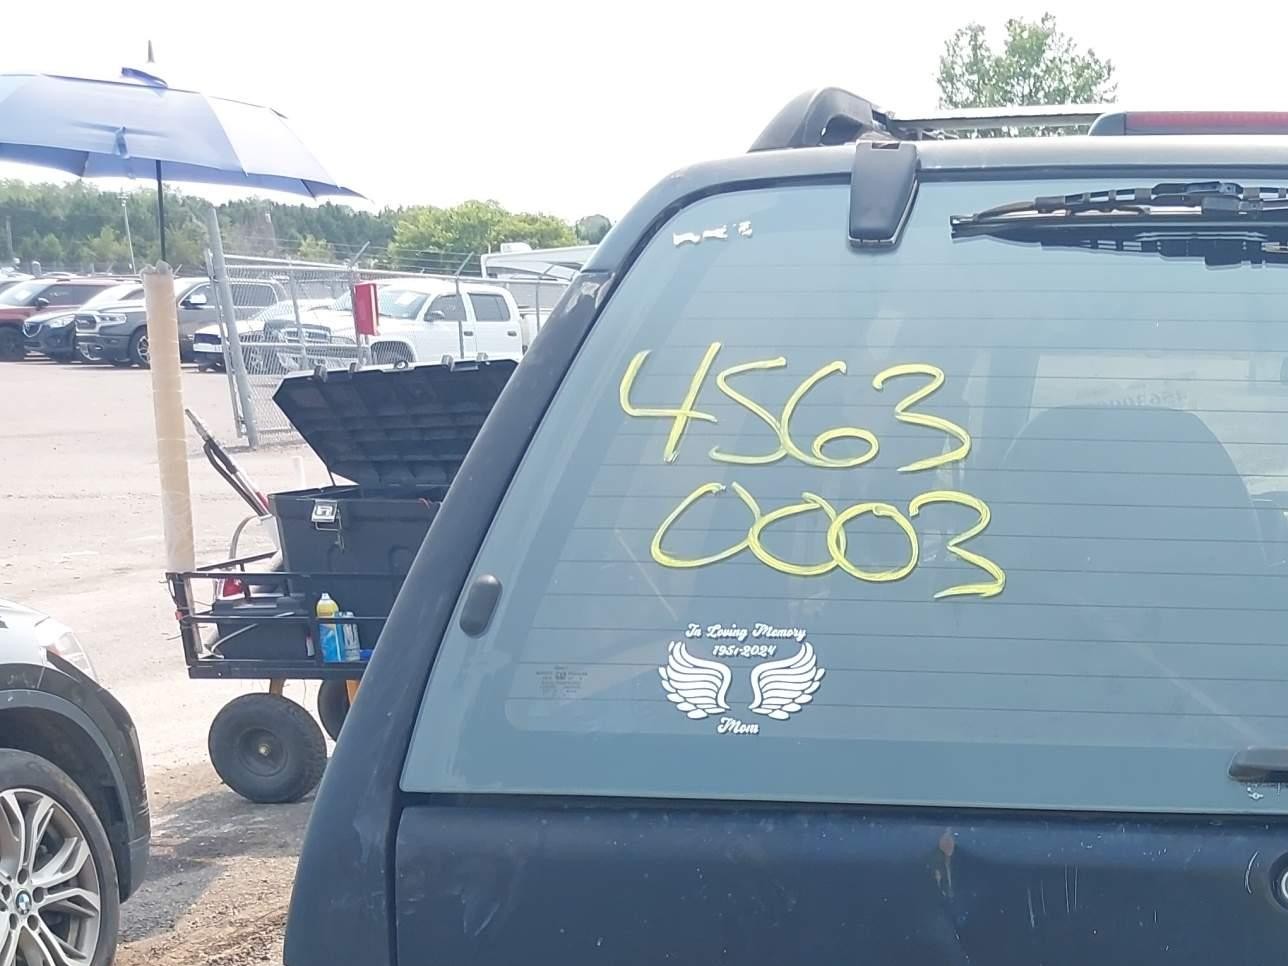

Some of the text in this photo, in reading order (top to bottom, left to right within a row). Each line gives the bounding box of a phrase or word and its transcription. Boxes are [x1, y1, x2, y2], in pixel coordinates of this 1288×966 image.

[619, 342, 971, 471] 4563
[651, 481, 1005, 598] 0003
[685, 623, 806, 642] In Loving Memory
[712, 644, 777, 657] 1951-2024
[717, 717, 759, 734] Mom
